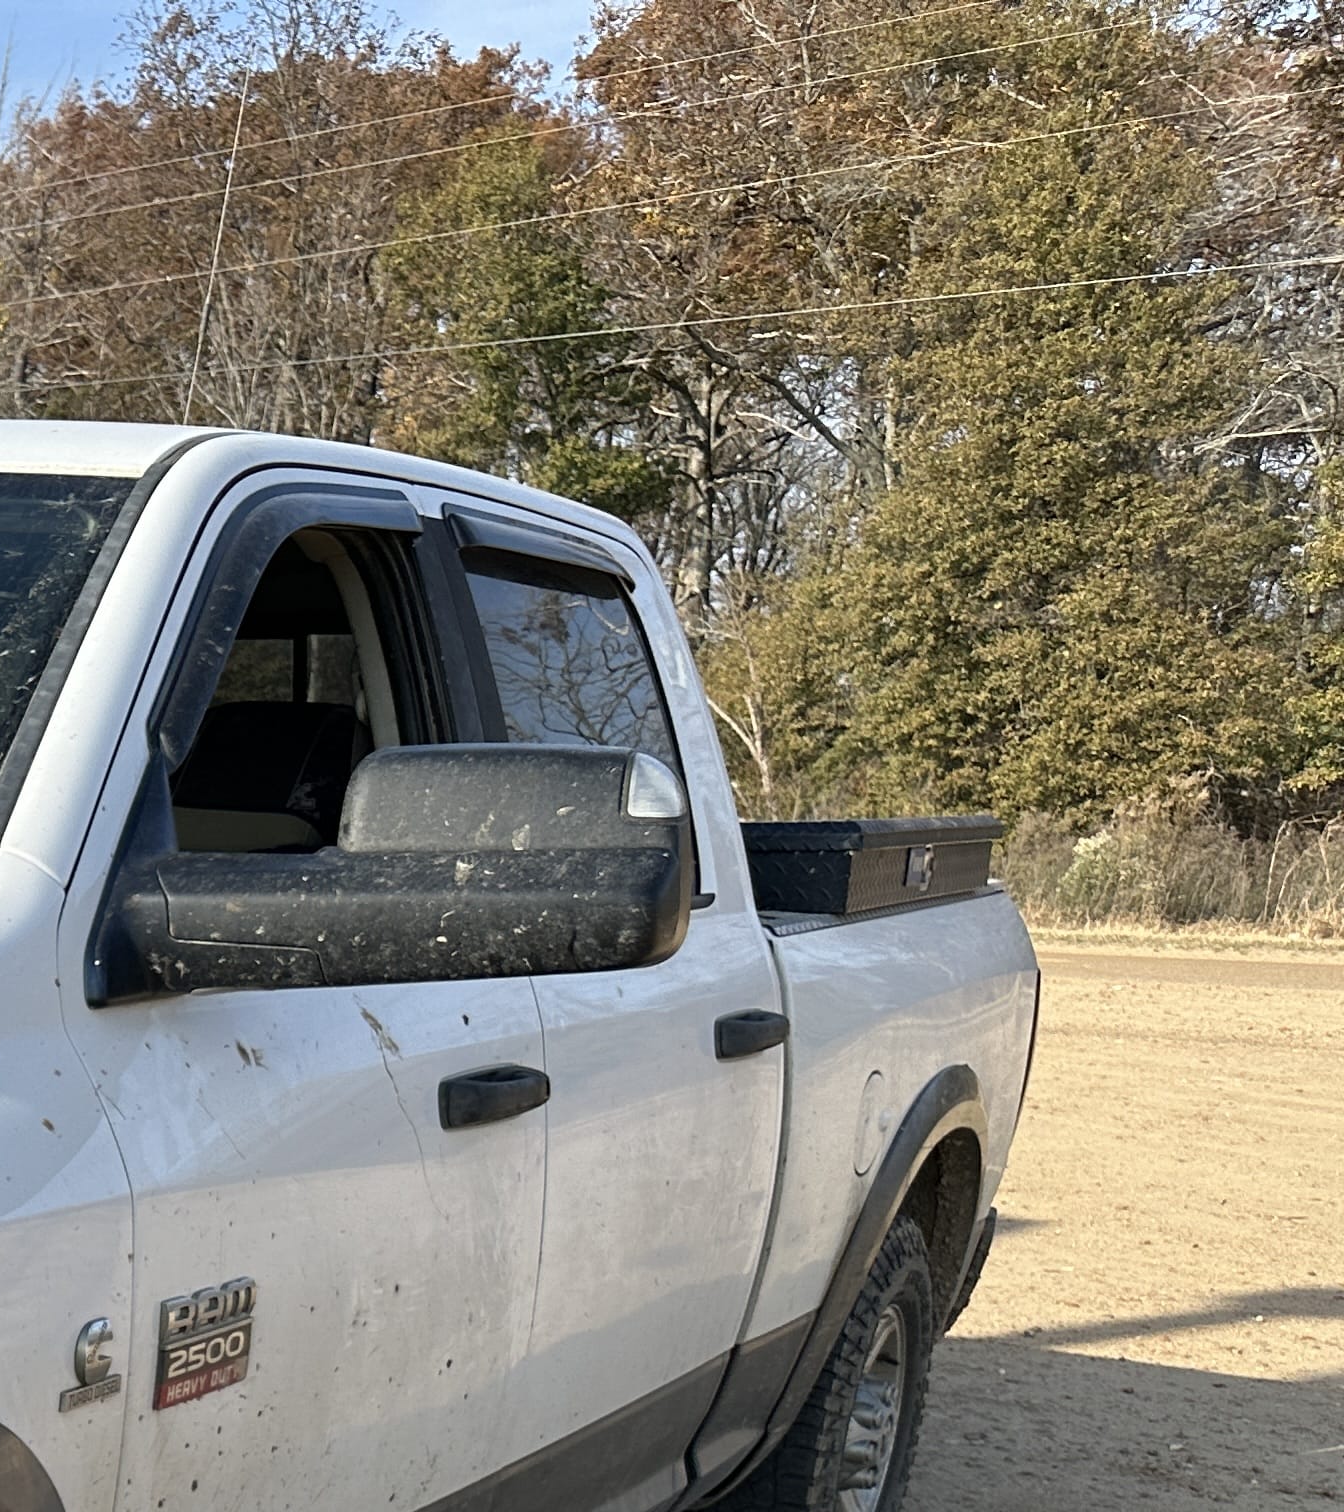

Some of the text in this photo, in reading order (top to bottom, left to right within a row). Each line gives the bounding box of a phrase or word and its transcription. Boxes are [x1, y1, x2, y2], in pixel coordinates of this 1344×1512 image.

[163, 1276, 258, 1338] RAM
[167, 1330, 246, 1378] 2500
[166, 1374, 207, 1402] HEAVY
